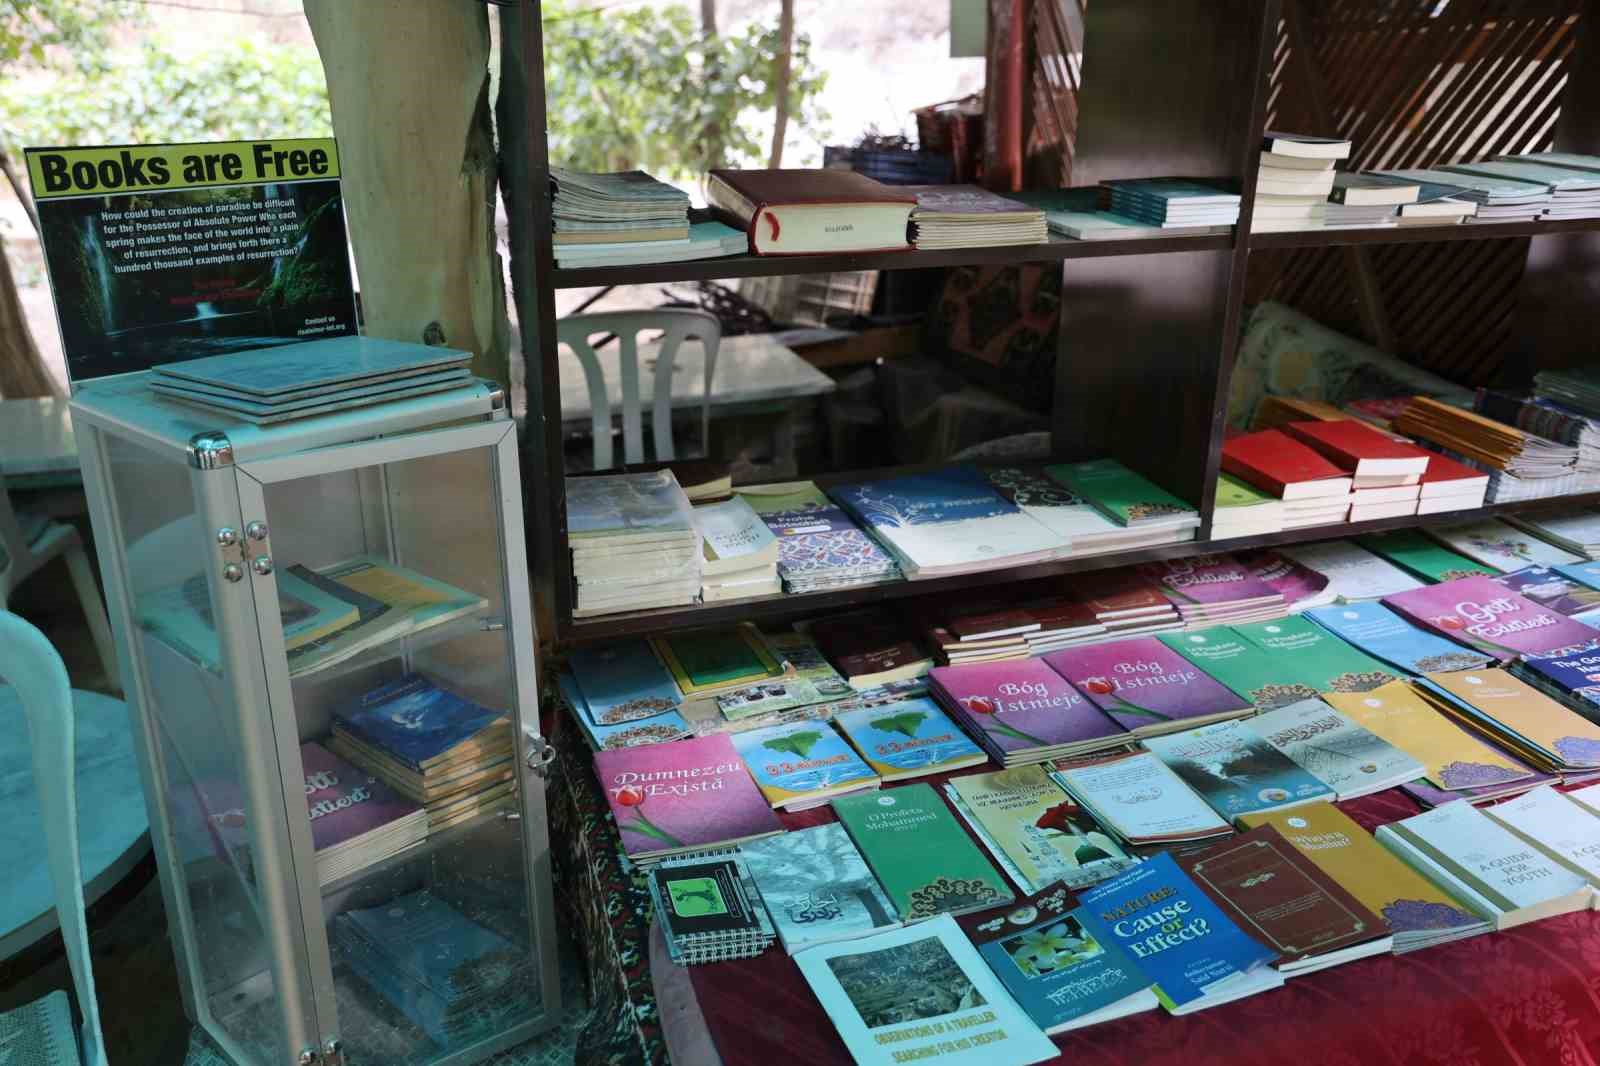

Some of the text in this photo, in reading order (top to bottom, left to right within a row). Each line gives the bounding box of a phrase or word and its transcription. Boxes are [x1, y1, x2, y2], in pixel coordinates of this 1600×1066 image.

[39, 144, 329, 192] Books are Free
[101, 198, 295, 221] How could the creation of paradise be difficult
[103, 211, 297, 234] for the Possessor of Absolute Power Who each
[105, 238, 135, 248] spring
[137, 235, 166, 245] makes
[168, 233, 182, 242] the
[184, 232, 203, 241] face
[204, 230, 213, 239] of
[215, 229, 229, 238] the
[230, 226, 254, 236] world
[255, 225, 271, 234] into
[279, 222, 299, 233] plain
[123, 250, 133, 259] of
[135, 246, 192, 258] resurrection,
[193, 243, 209, 252] and
[211, 240, 237, 250] brings
[238, 239, 258, 248] forth
[260, 237, 280, 246] there
[114, 247, 298, 273] hundred thousand examples of resurrection?
[1455, 598, 1521, 624] Gott
[1465, 614, 1556, 638] Existiert
[1113, 660, 1164, 675] Bóg
[998, 681, 1049, 698] Bóg
[614, 762, 741, 784] Dumnezeu
[645, 777, 724, 796] Există
[1489, 852, 1534, 870] GUIDE
[1502, 863, 1529, 876] FOR
[1503, 867, 1553, 886] YOUTH
[1114, 900, 1192, 937] Cause
[1162, 918, 1184, 933] or
[1128, 918, 1211, 958] Effect?
